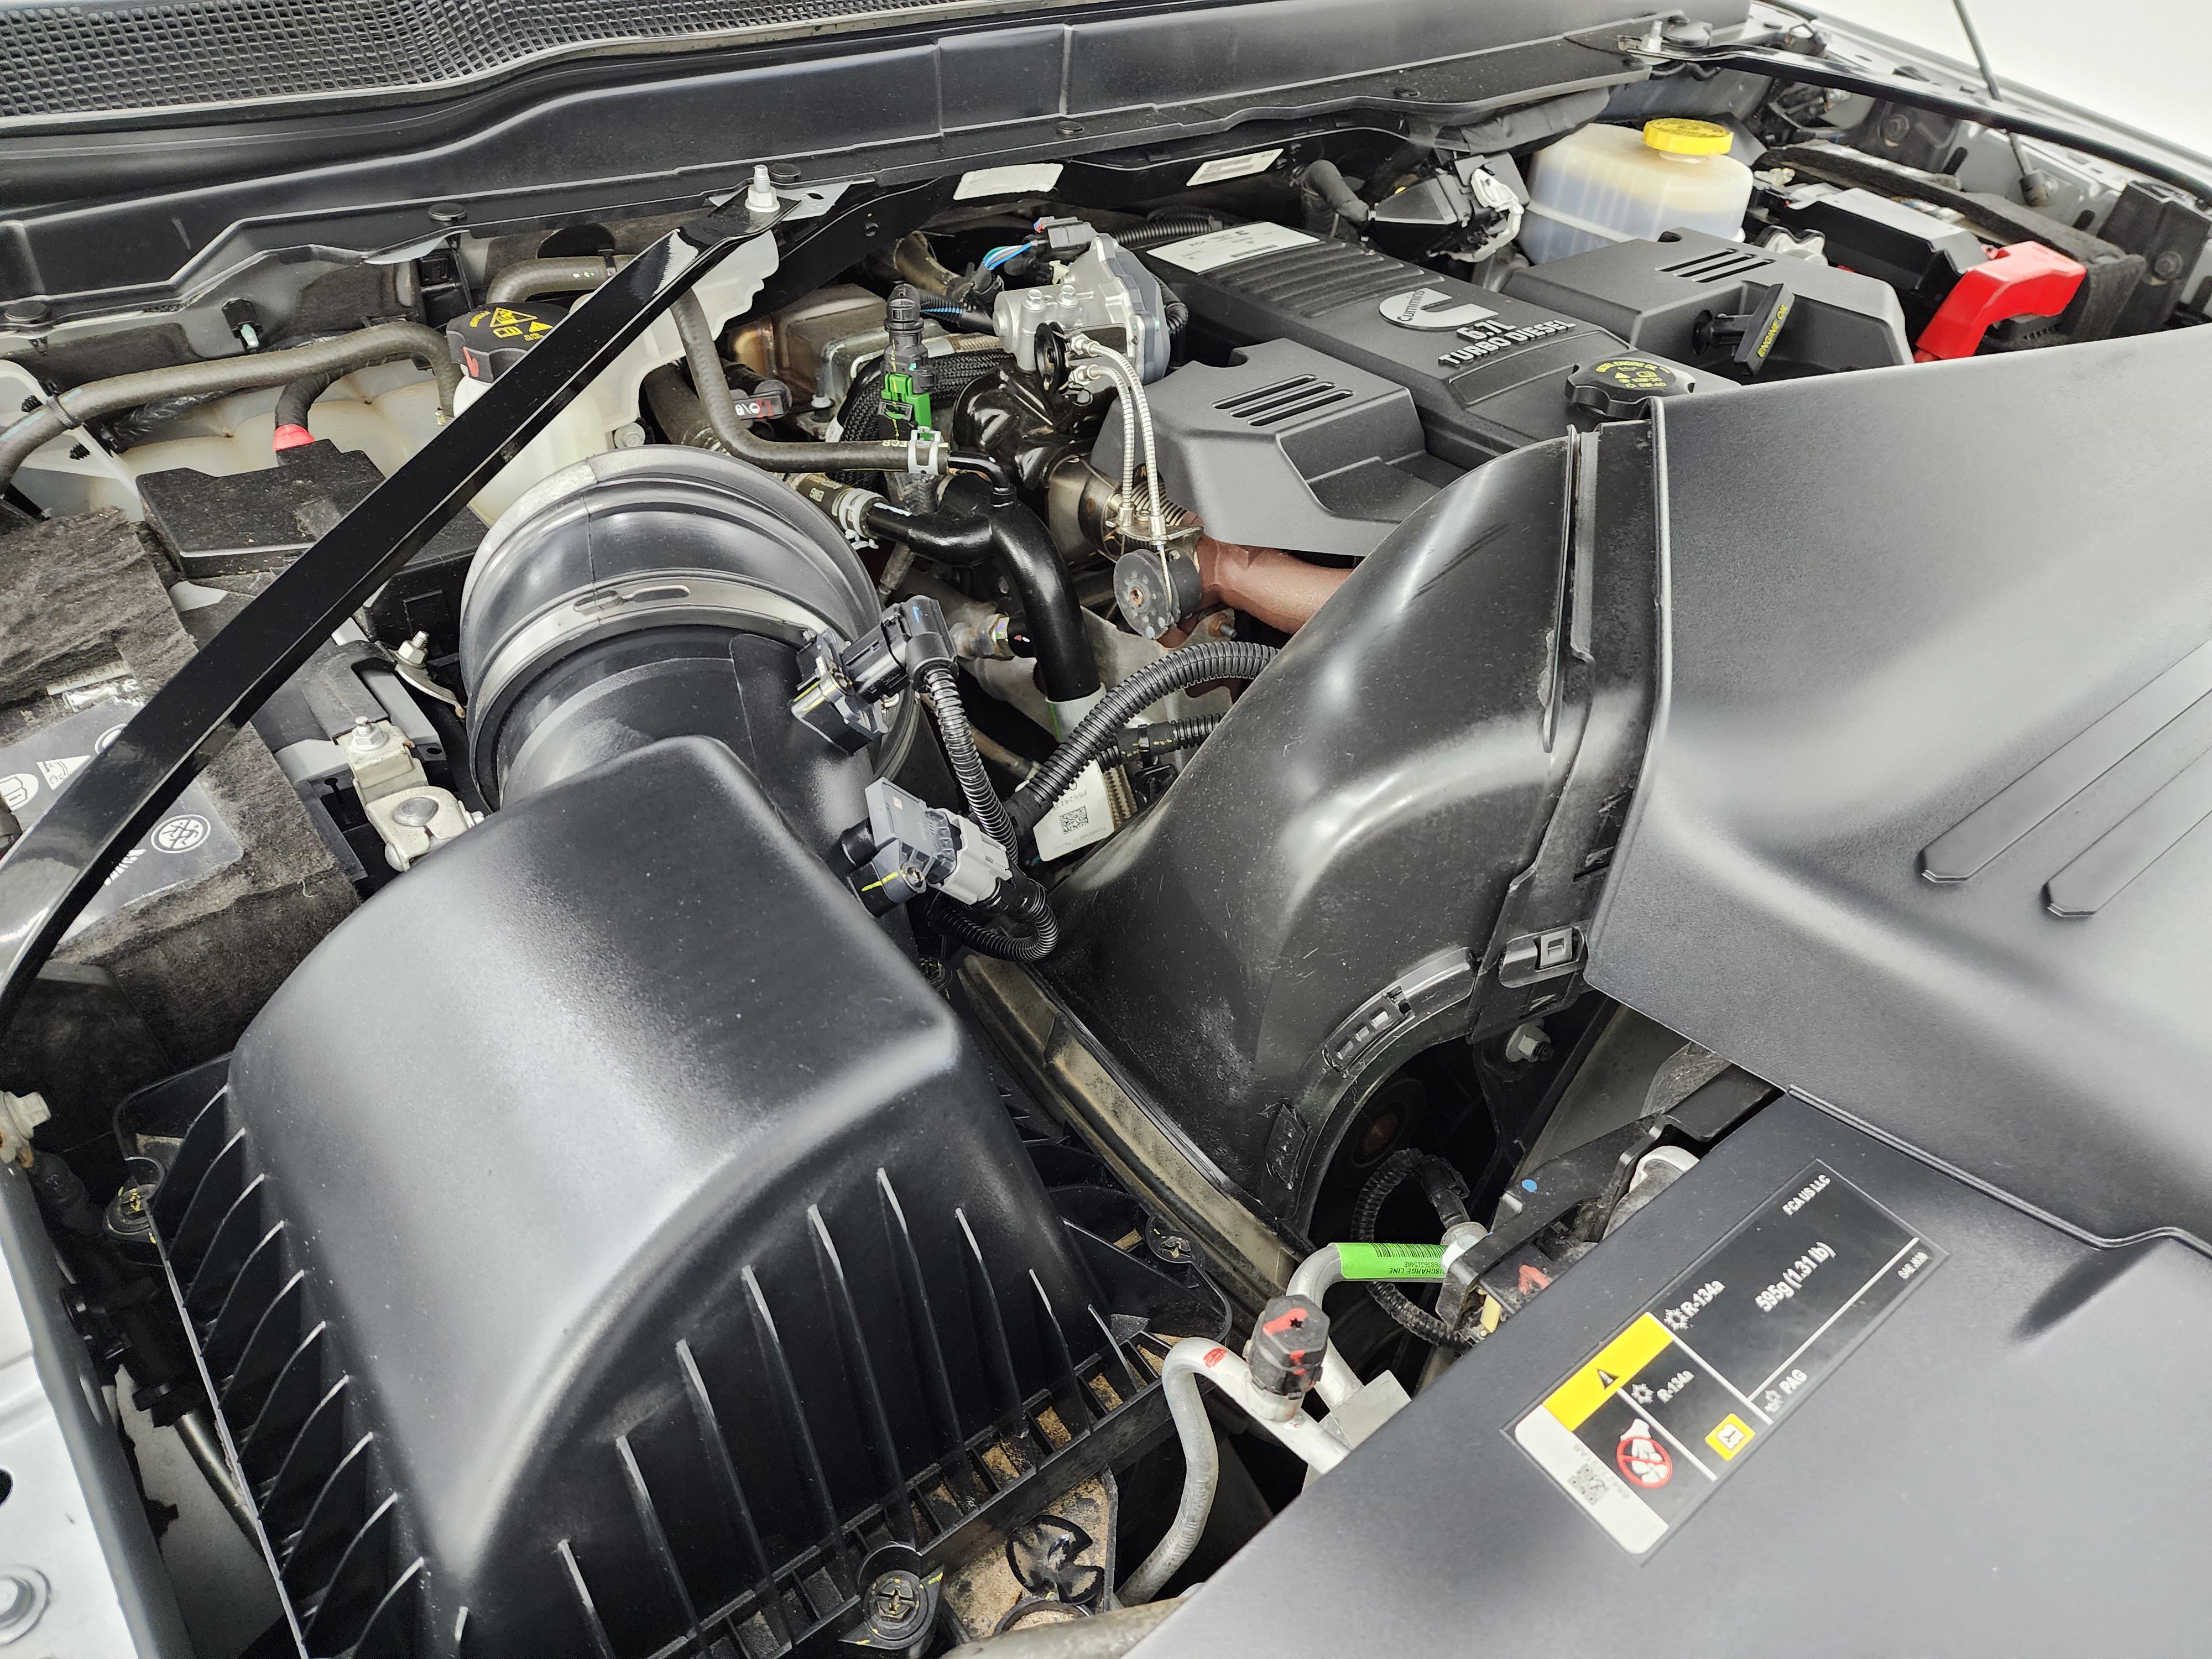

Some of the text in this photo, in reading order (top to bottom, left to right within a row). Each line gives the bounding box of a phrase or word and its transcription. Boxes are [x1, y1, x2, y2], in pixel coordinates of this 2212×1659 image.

[1397, 290, 1425, 322] Cummins
[1438, 319, 1577, 365] TURBO DIESEL
[1456, 319, 1517, 340] 6.7L
[1757, 319, 1780, 358] ENGINE
[809, 487, 825, 502] ENG
[1782, 1175, 1831, 1216] FCA US LLC
[1754, 1241, 1837, 1313] 595g (1.31 lb)
[1897, 1262, 1916, 1280] SAE
[1680, 1280, 1726, 1318] R-134a
[1657, 1370, 1695, 1404] R-134a
[1779, 1369, 1808, 1395] PAG
